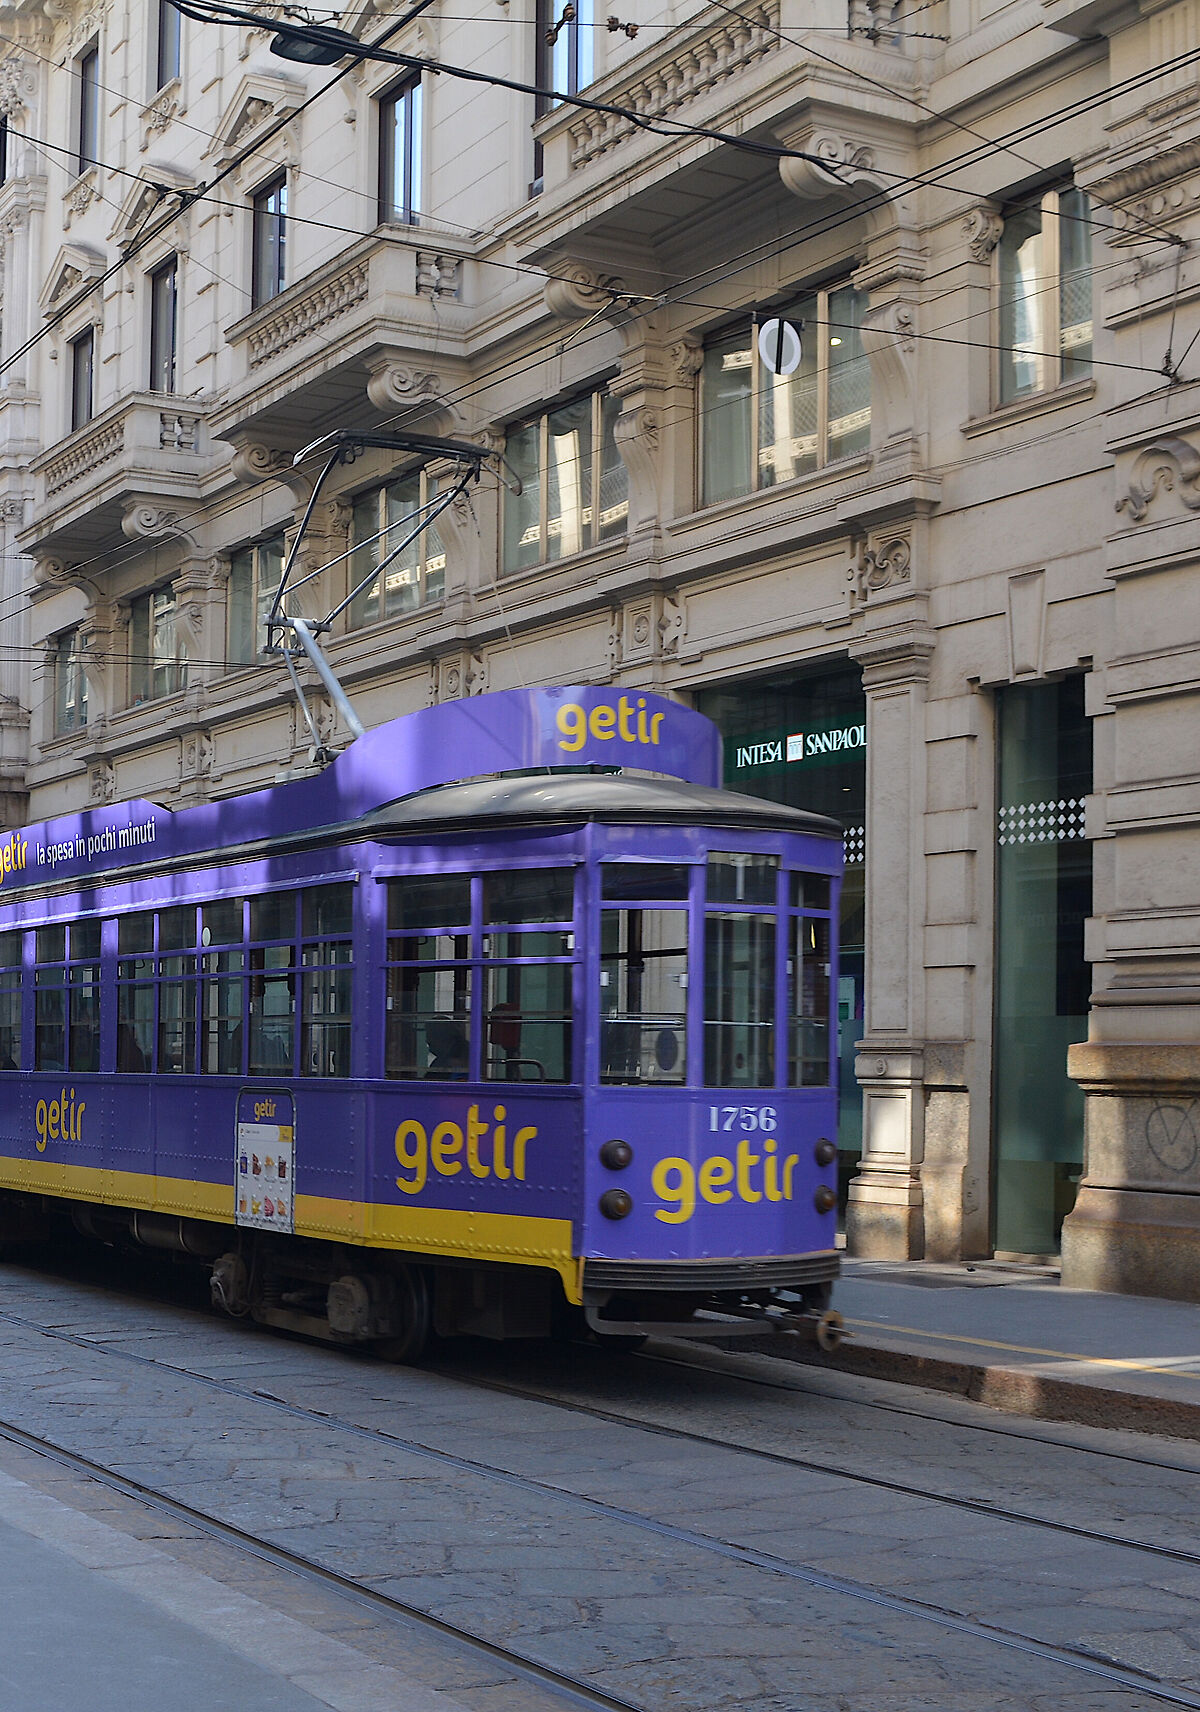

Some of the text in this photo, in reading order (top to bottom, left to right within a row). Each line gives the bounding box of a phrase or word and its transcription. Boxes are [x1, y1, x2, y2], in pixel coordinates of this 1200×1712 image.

[556, 696, 665, 752] getir
[736, 741, 782, 768] INTESA
[36, 843, 46, 865] la
[47, 840, 74, 869] spesa
[75, 834, 86, 857] in
[88, 825, 116, 861] pochi
[118, 816, 156, 849] minuti
[36, 1088, 86, 1152] getir
[254, 1098, 276, 1121] getir
[709, 1107, 777, 1132] 1756
[395, 1104, 537, 1194] getir
[651, 1138, 798, 1224] getir
